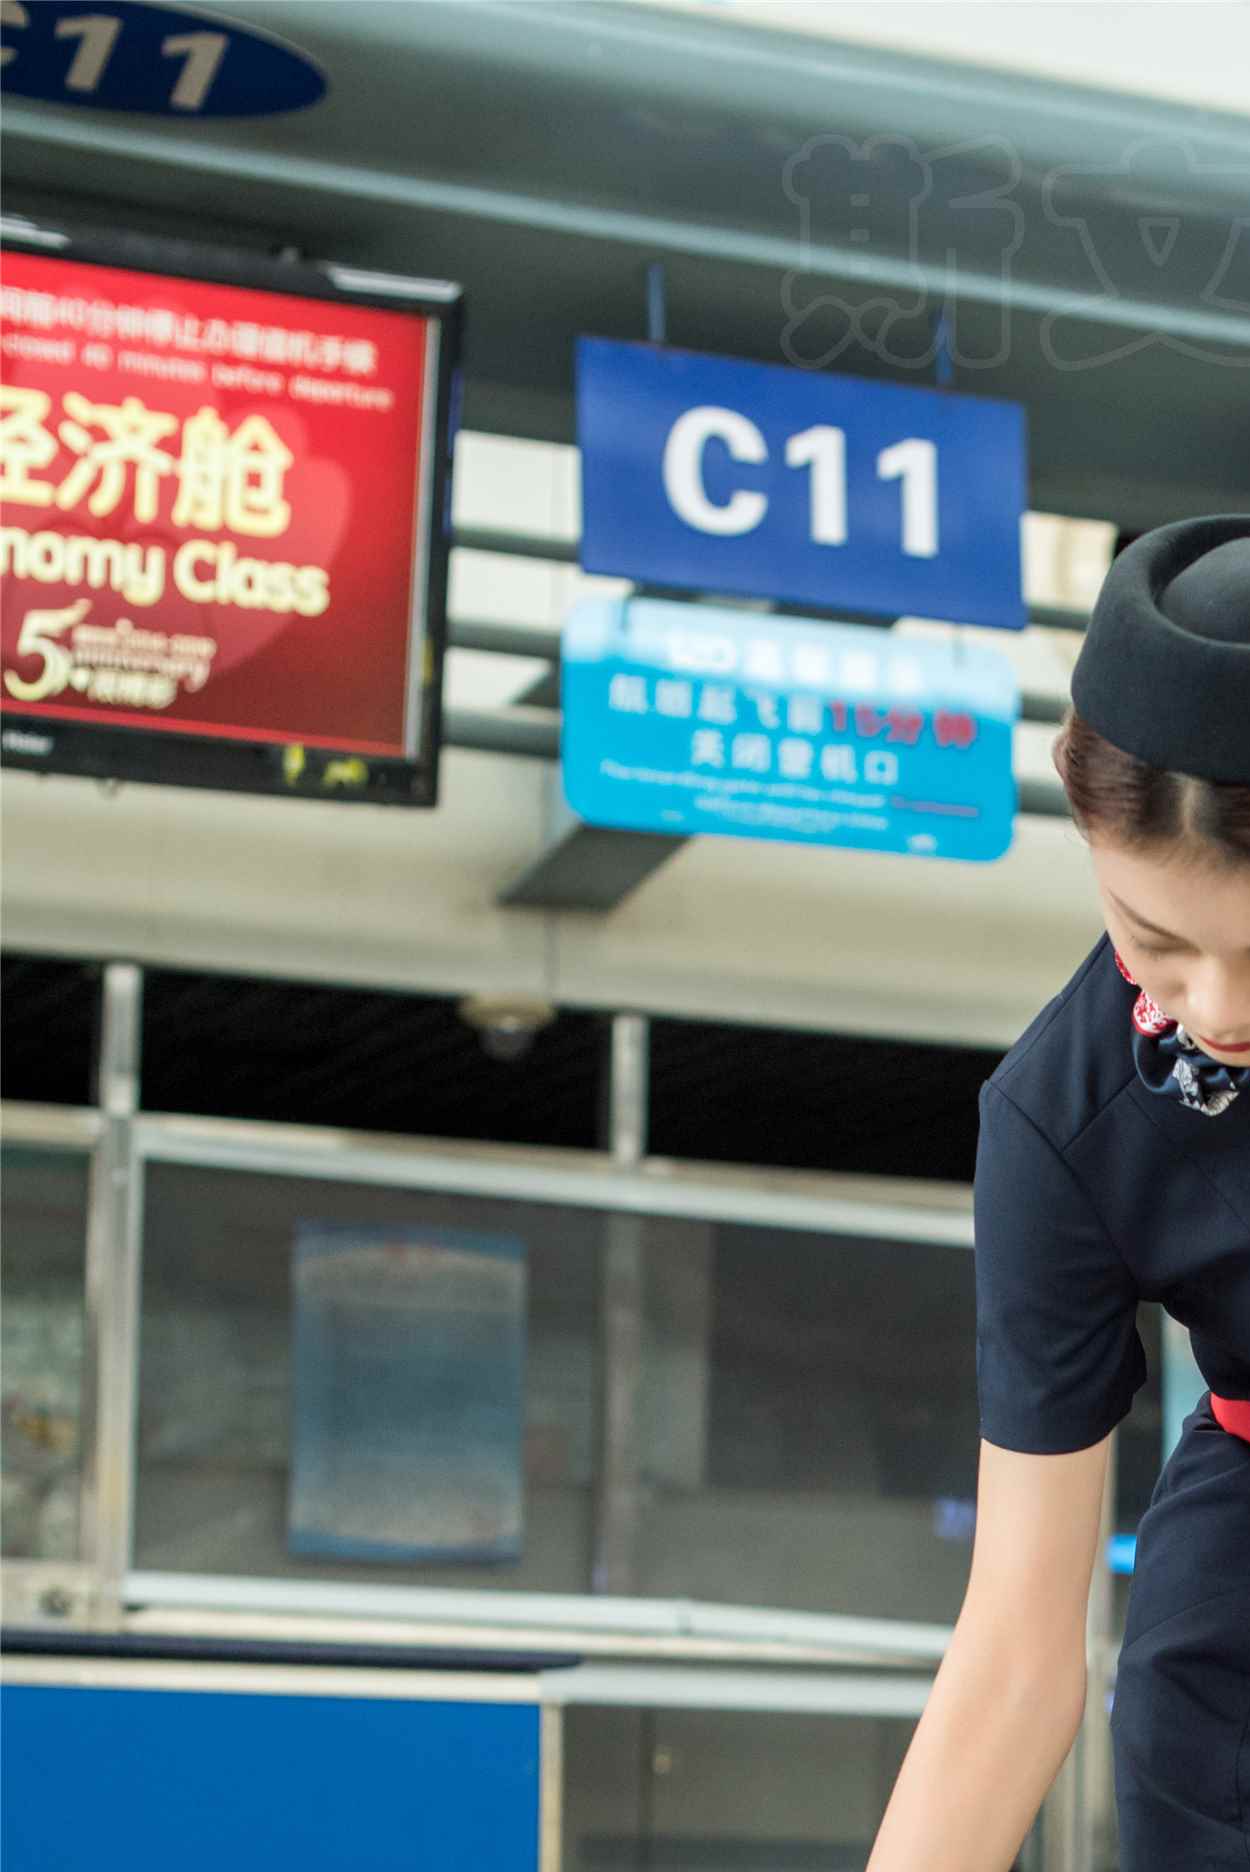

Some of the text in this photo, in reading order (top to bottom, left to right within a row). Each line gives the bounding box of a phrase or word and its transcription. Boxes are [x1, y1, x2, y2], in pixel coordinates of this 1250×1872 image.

[0, 0, 228, 111] 11
[662, 405, 939, 558] C11
[173, 538, 330, 617] Class
